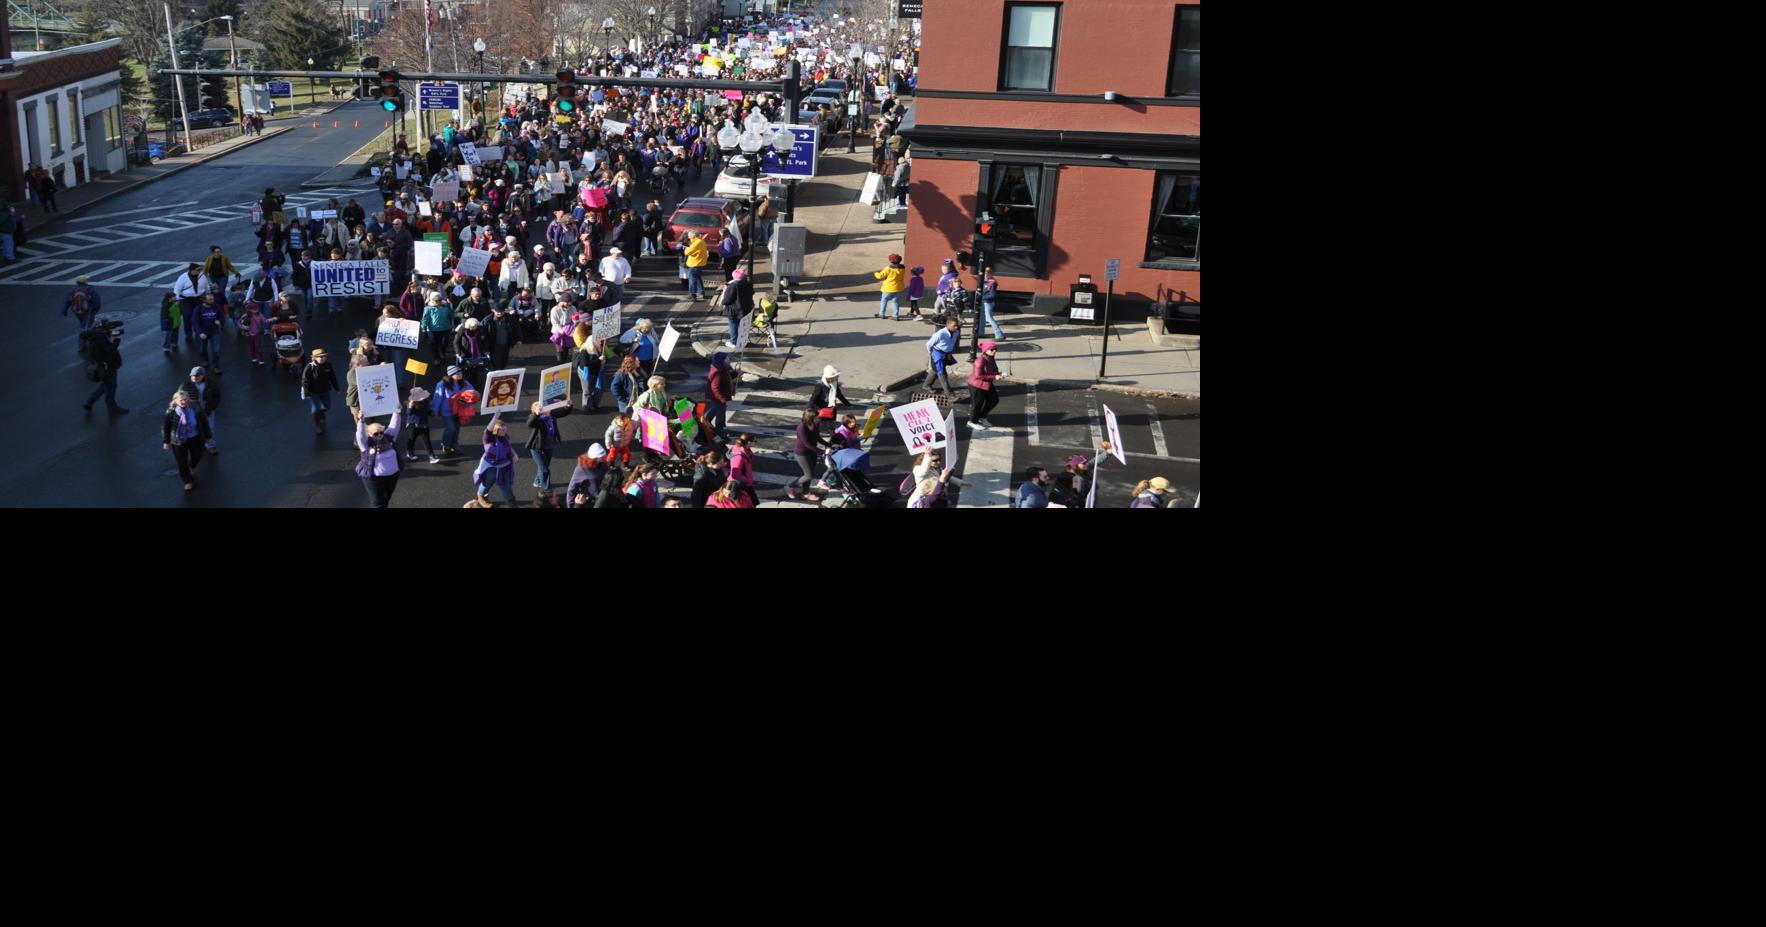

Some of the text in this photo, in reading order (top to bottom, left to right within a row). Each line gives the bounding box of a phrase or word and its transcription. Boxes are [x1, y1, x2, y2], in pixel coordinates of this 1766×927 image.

[314, 268, 375, 283] UNITED
[315, 281, 387, 295] RESIST
[377, 332, 418, 346] REGRESS
[903, 408, 930, 421] HEAR
[909, 423, 935, 434] VOICE
